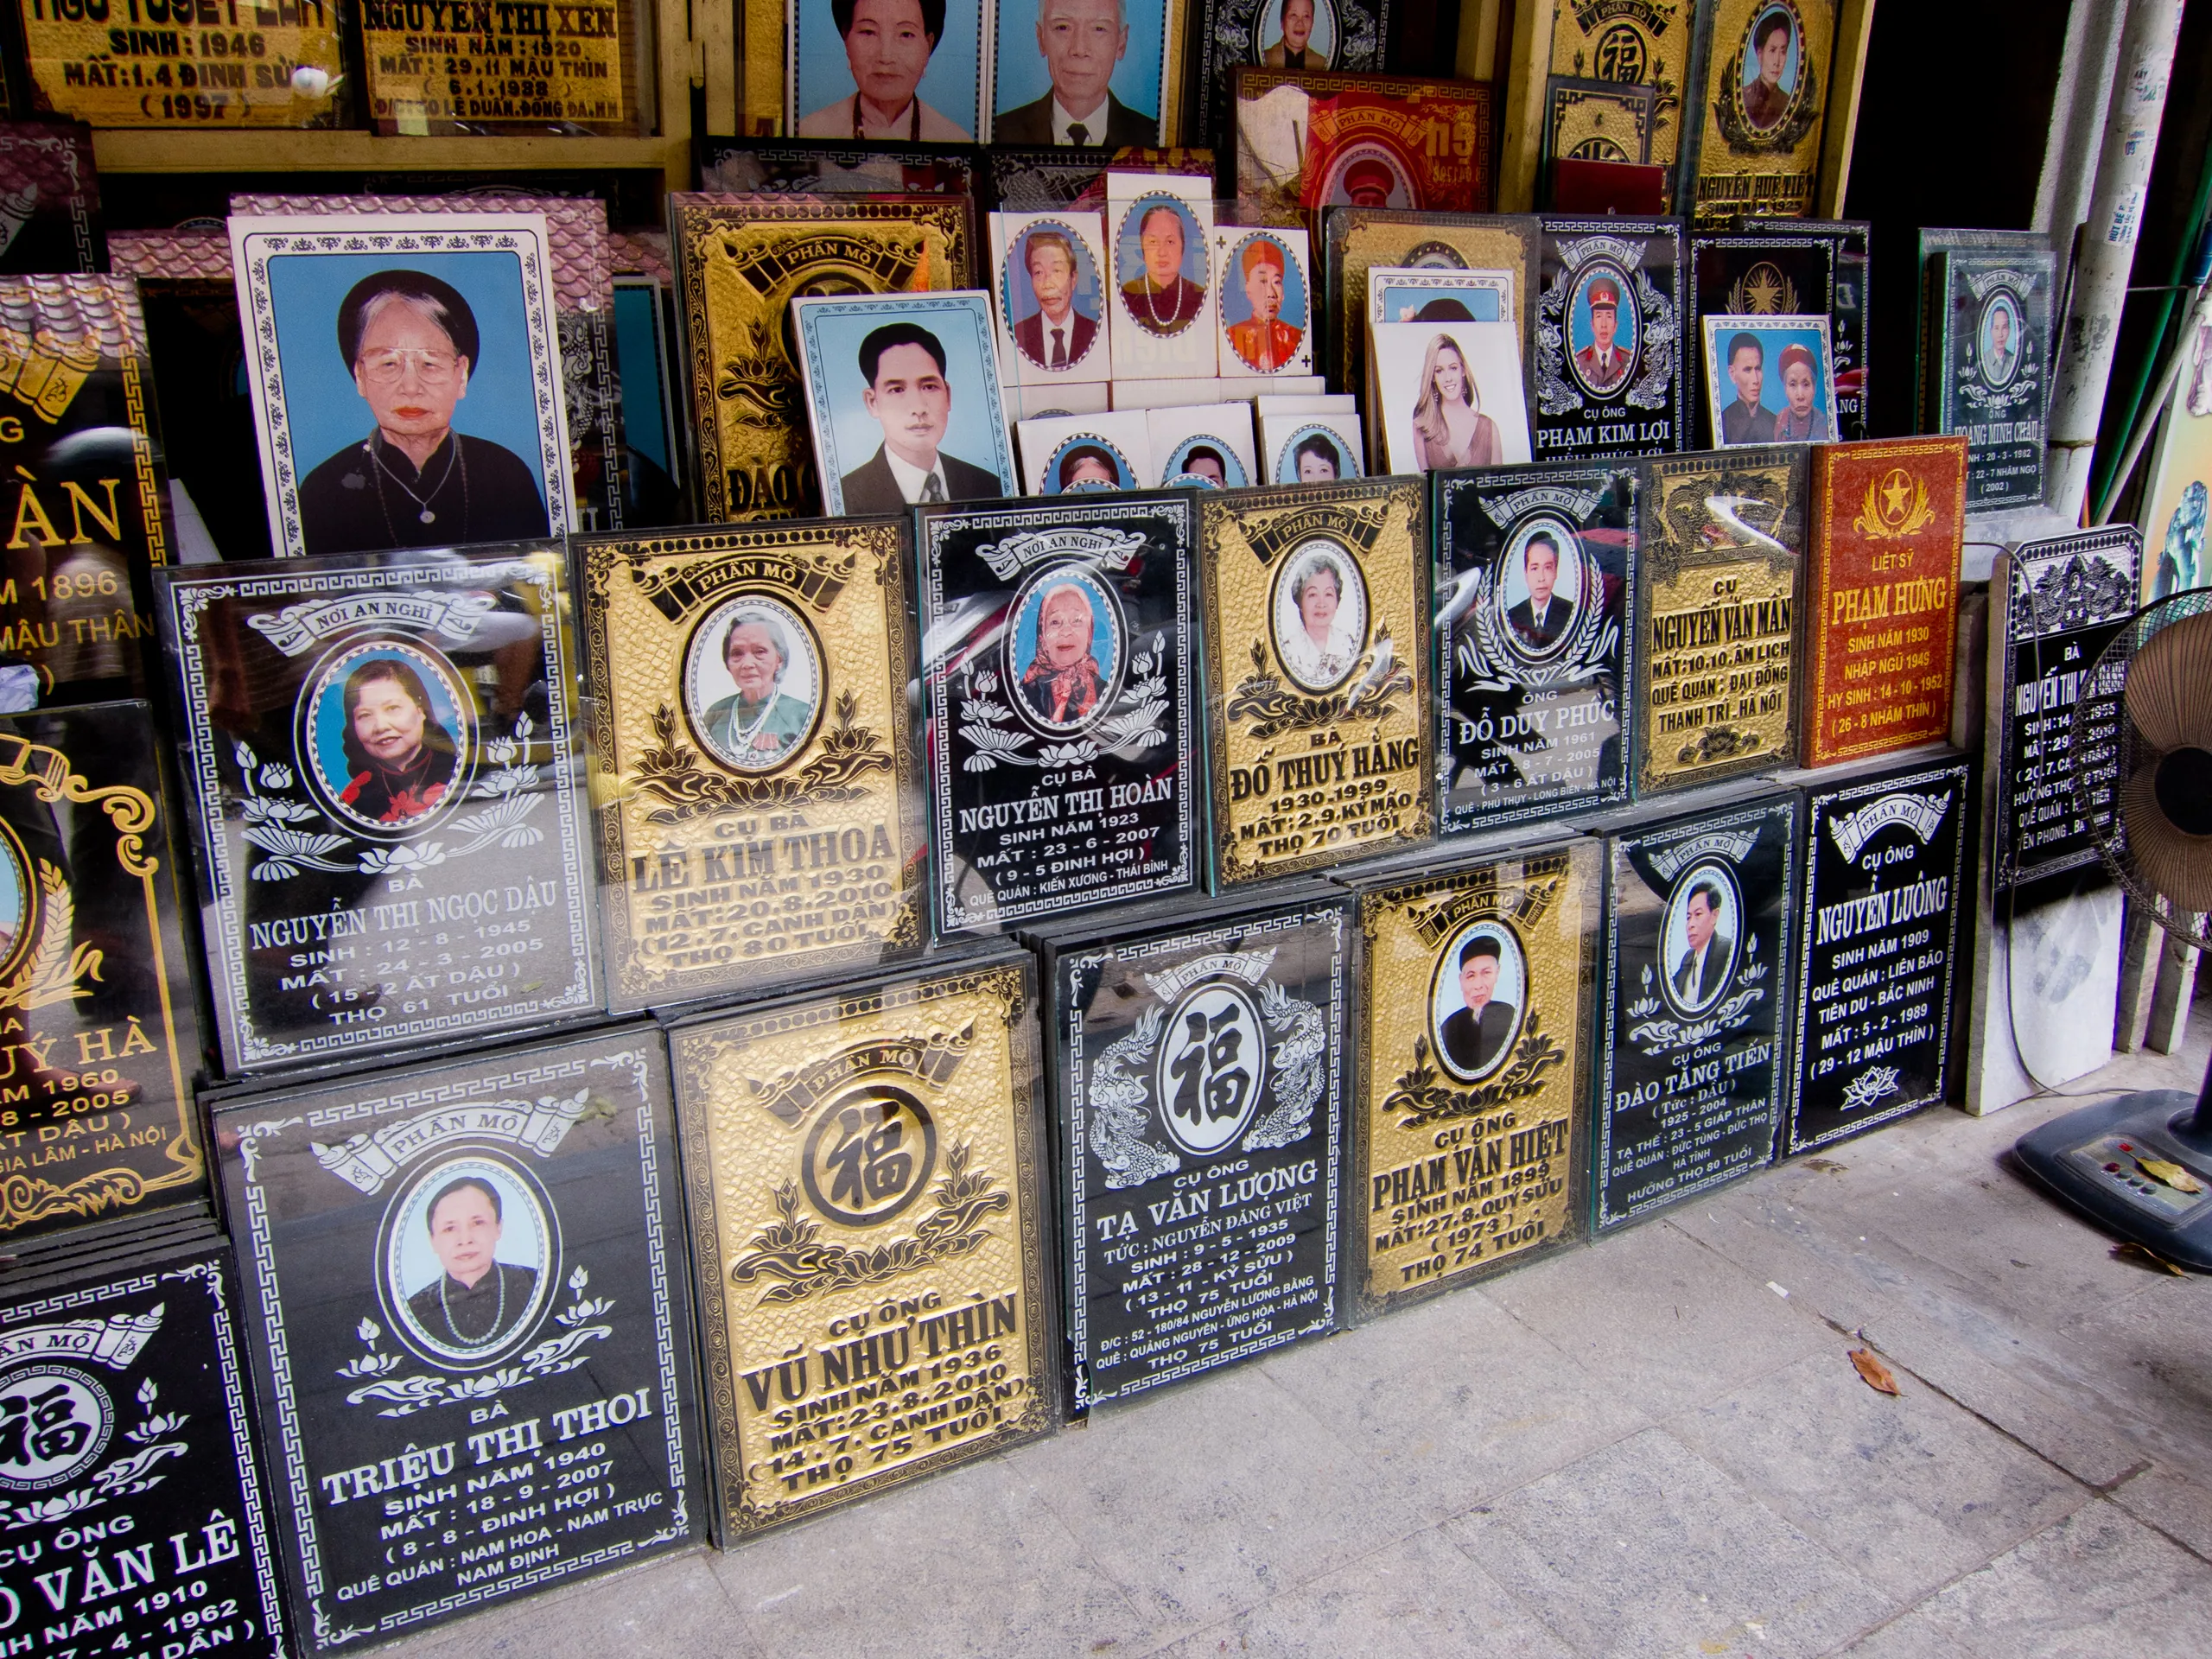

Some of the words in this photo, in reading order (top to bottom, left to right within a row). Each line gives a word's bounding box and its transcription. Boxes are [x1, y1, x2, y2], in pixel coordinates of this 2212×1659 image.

[788, 238, 838, 265] PHẦN
[844, 244, 871, 265] MỘ
[1584, 408, 1600, 423] CỤ
[1603, 405, 1625, 419] ÔNG
[1988, 407, 2006, 419] ÔNG
[1538, 427, 1592, 451] PHẠM
[1599, 427, 1636, 445] KIM
[1640, 421, 1669, 442] LỢI
[1989, 422, 2012, 443] MINH
[1986, 482, 2004, 493] 2002
[1282, 513, 1322, 538] PHẦN
[1326, 514, 1348, 532] MỘ
[1023, 540, 1046, 558] NƠI
[1049, 537, 1067, 547] AN
[1071, 536, 1103, 549] NGHỈ
[1872, 550, 1897, 574] LIỆT
[31, 570, 118, 601] 1896
[696, 562, 757, 593] PHẦN
[763, 563, 797, 582] MỘ
[315, 608, 349, 631] NƠI
[355, 603, 379, 618] AN
[385, 602, 433, 622] NGHỈ
[1832, 585, 1891, 630] PHẠM
[67, 609, 155, 644] THÂN
[1653, 600, 1720, 653] NGUYỄN
[1847, 635, 1874, 654] SINH
[1878, 628, 1902, 647] NĂM
[1906, 626, 1929, 644] 1930
[1845, 660, 1877, 680] NHẬP
[1879, 652, 1904, 672] NGŨ
[2064, 640, 2080, 661] BÀ
[1522, 690, 1558, 704] ÔNG
[1311, 727, 1343, 747] BÀ
[1459, 707, 1493, 744] ĐỖ
[1500, 710, 1549, 738] DUY
[1659, 711, 1703, 733] THANH
[1481, 745, 1518, 759] SINH
[1523, 737, 1558, 753] NĂM
[1563, 732, 1595, 746] 1961
[1042, 772, 1065, 787] CỤ
[1071, 765, 1096, 781] BÀ
[1230, 747, 1274, 801] ĐỖ
[959, 785, 1059, 833] NGUYỄN
[1065, 787, 1104, 817] THỊ
[1109, 774, 1172, 809] HOÀN
[1900, 805, 1919, 822] MỘ
[715, 821, 758, 842] CỤ
[769, 811, 810, 831] BÀ
[1000, 826, 1045, 845] SINH
[1052, 821, 1093, 838] NĂM
[1099, 812, 1140, 829] 1923
[632, 840, 689, 893] LÊ
[702, 839, 774, 883] KIM
[783, 823, 896, 873] THOA
[1259, 834, 1303, 855] THỌ
[1862, 853, 1882, 872] CỤ
[1885, 844, 1915, 864] ÔNG
[387, 878, 425, 893] BÀ
[650, 886, 731, 912] SINH
[739, 877, 799, 899] NĂM
[809, 865, 886, 888] 1930
[250, 897, 365, 950] NGUYỄN
[373, 899, 421, 934] THỊ
[428, 889, 499, 925] NGỌC
[1817, 875, 1891, 945] NGUYỄN
[665, 946, 732, 967] THỌ
[744, 937, 787, 958] 80
[1832, 949, 1865, 969] SINH
[1868, 938, 1897, 959] NĂM
[1901, 929, 1929, 950] 1909
[1223, 959, 1242, 972] MỘ
[329, 1005, 387, 1027] THỌ
[404, 998, 429, 1014] 61
[448, 983, 509, 1007] TUỔI
[74, 1015, 157, 1065] HÀ
[1672, 1055, 1690, 1067] CỤ
[1694, 1042, 1721, 1059] ÔNG
[813, 1053, 872, 1091] PHẦN
[880, 1046, 915, 1068] MỘ
[1172, 1003, 1250, 1126] 福
[1616, 1082, 1660, 1112] ĐÀO
[1666, 1062, 1720, 1094] TĂNG
[1725, 1038, 1770, 1073] TIẾN
[43, 1069, 118, 1095] 1960
[52, 1090, 130, 1117] 2005
[95, 1133, 125, 1154] HÀ
[130, 1126, 167, 1147] NỘI
[390, 1115, 467, 1154] PHẦN
[476, 1114, 518, 1133] MỘ
[1434, 1127, 1464, 1150] CỤ
[1471, 1112, 1516, 1137] ÔNG
[32, 1145, 75, 1166] LÂM
[826, 1100, 913, 1210] 福
[1673, 1158, 1687, 1170] HÀ
[1173, 1171, 1201, 1189] CỤ
[1207, 1160, 1249, 1179] ÔNG
[1373, 1156, 1446, 1212] PHẠM
[1453, 1137, 1503, 1185] VĂN
[1678, 1167, 1704, 1185] THỌ
[1707, 1160, 1720, 1172] 80
[1096, 1211, 1139, 1242] TẠ
[1148, 1189, 1211, 1225] VĂN
[1219, 1160, 1318, 1208] LƯỢNG
[1392, 1195, 1446, 1224] SINH
[1452, 1181, 1493, 1205] NĂM
[1502, 1162, 1549, 1190] 1899
[1401, 1255, 1446, 1281] THỌ
[1455, 1243, 1483, 1264] 74
[1493, 1209, 1544, 1249] TUỔI
[829, 1312, 870, 1338] CỤ
[878, 1292, 942, 1323] ÔNG
[1147, 1300, 1188, 1319] THỌ
[1198, 1288, 1220, 1304] 75
[48, 1332, 91, 1352] MỘ
[742, 1343, 807, 1413] VŨ
[821, 1315, 915, 1392] NHƯ
[918, 1292, 1018, 1359] THÌN
[1147, 1350, 1188, 1370] THỌ
[1198, 1339, 1220, 1354] 75
[1230, 1320, 1274, 1344] TUỔI
[773, 1389, 851, 1428] SINH
[856, 1370, 920, 1405] NĂM
[926, 1344, 1003, 1378] 1936
[470, 1399, 510, 1424] BÀ
[321, 1441, 456, 1506] TRIỆU
[467, 1418, 543, 1458] THỊ
[552, 1387, 652, 1442] THOI
[782, 1455, 854, 1491] THỌ
[871, 1434, 914, 1463] 75
[925, 1405, 1003, 1444] TUỔI
[385, 1487, 457, 1516] SINH
[466, 1461, 533, 1497] NĂM
[543, 1442, 606, 1471] 1940
[54, 1515, 135, 1550] ÔNG
[34, 1546, 156, 1611] VĂN
[169, 1508, 240, 1577] LÊ
[456, 1561, 505, 1586] NAM
[510, 1543, 560, 1568] ĐỊNH
[45, 1605, 123, 1643] NĂM
[135, 1580, 207, 1616] 1910
[163, 1598, 238, 1630] 1962
